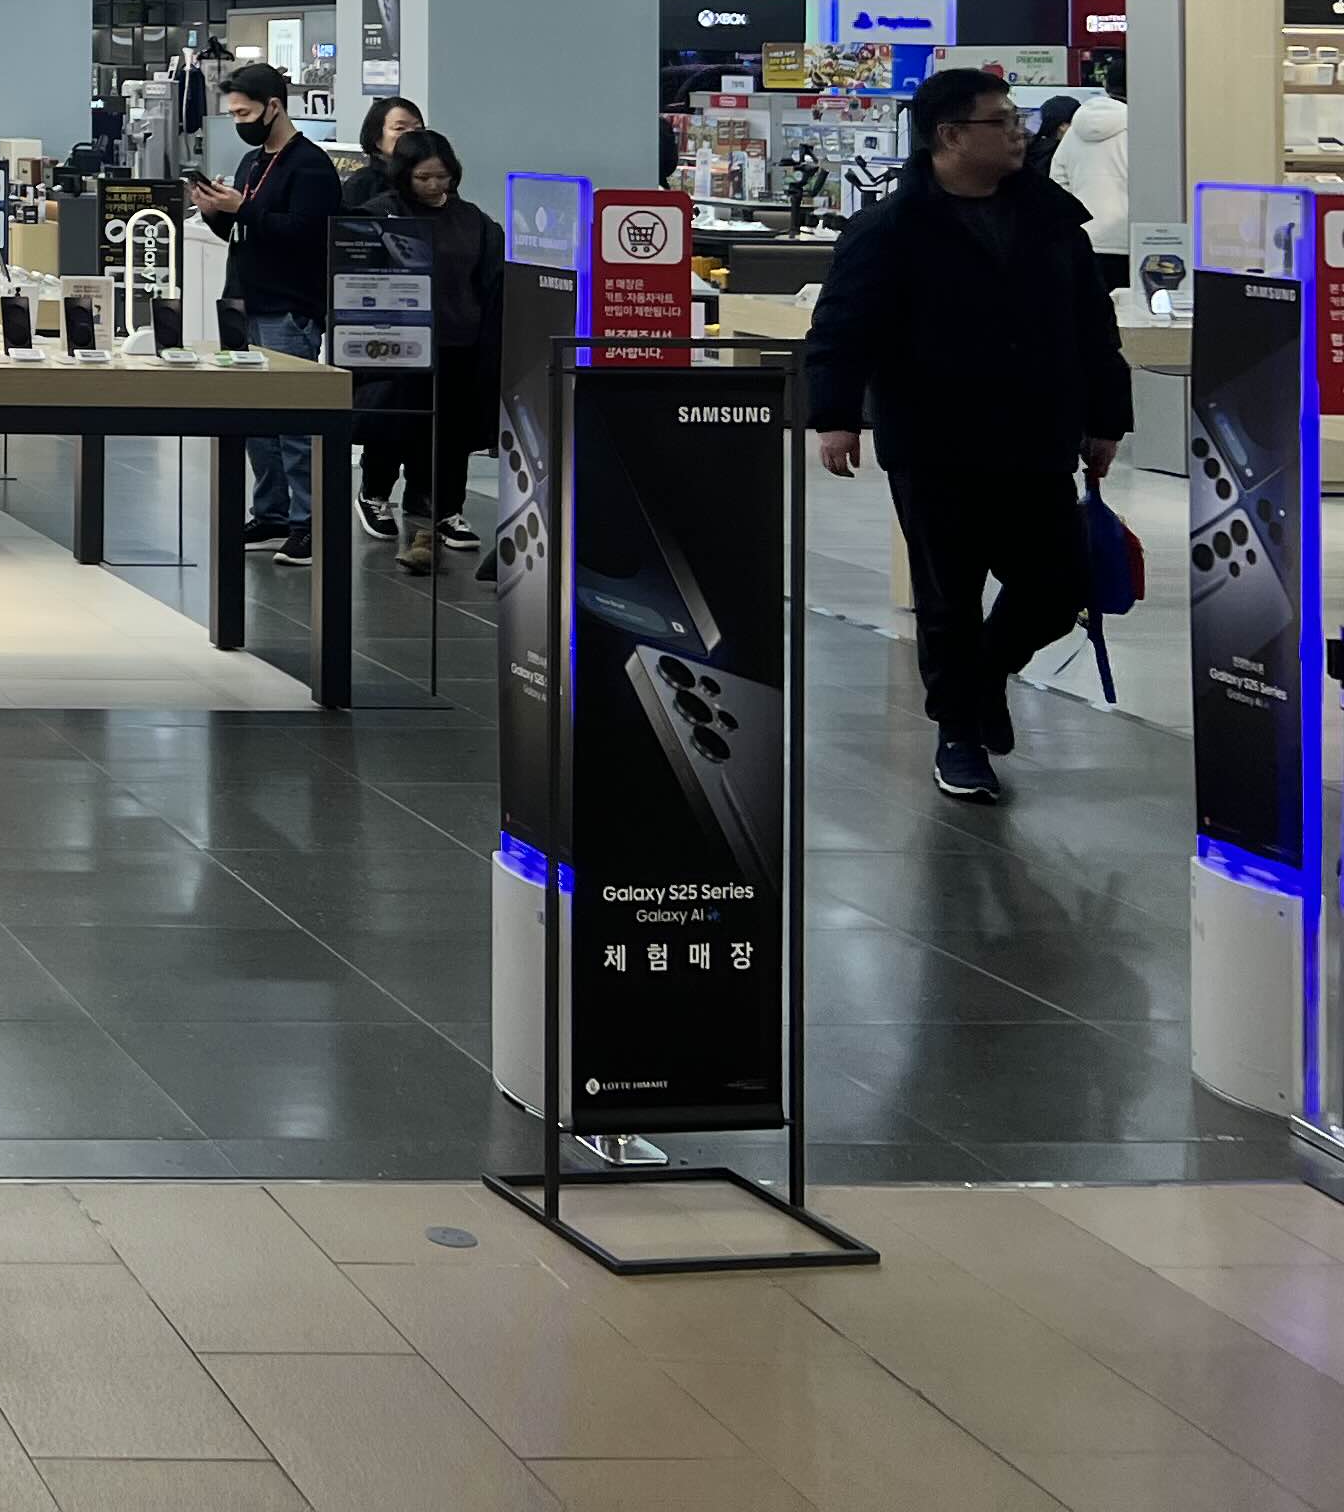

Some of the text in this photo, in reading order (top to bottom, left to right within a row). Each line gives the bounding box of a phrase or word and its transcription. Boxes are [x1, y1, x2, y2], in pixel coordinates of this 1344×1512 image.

[715, 12, 747, 26] XBOX
[141, 225, 158, 281] Galaxy
[539, 275, 574, 292] SAMSUNG
[1244, 284, 1296, 302] SAMSUNG
[678, 406, 771, 423] SAMSUNG
[602, 882, 754, 905] Galaxy S25 Series
[636, 908, 704, 925] Galaxy AI
[603, 941, 754, 972] 체 험 매 장
